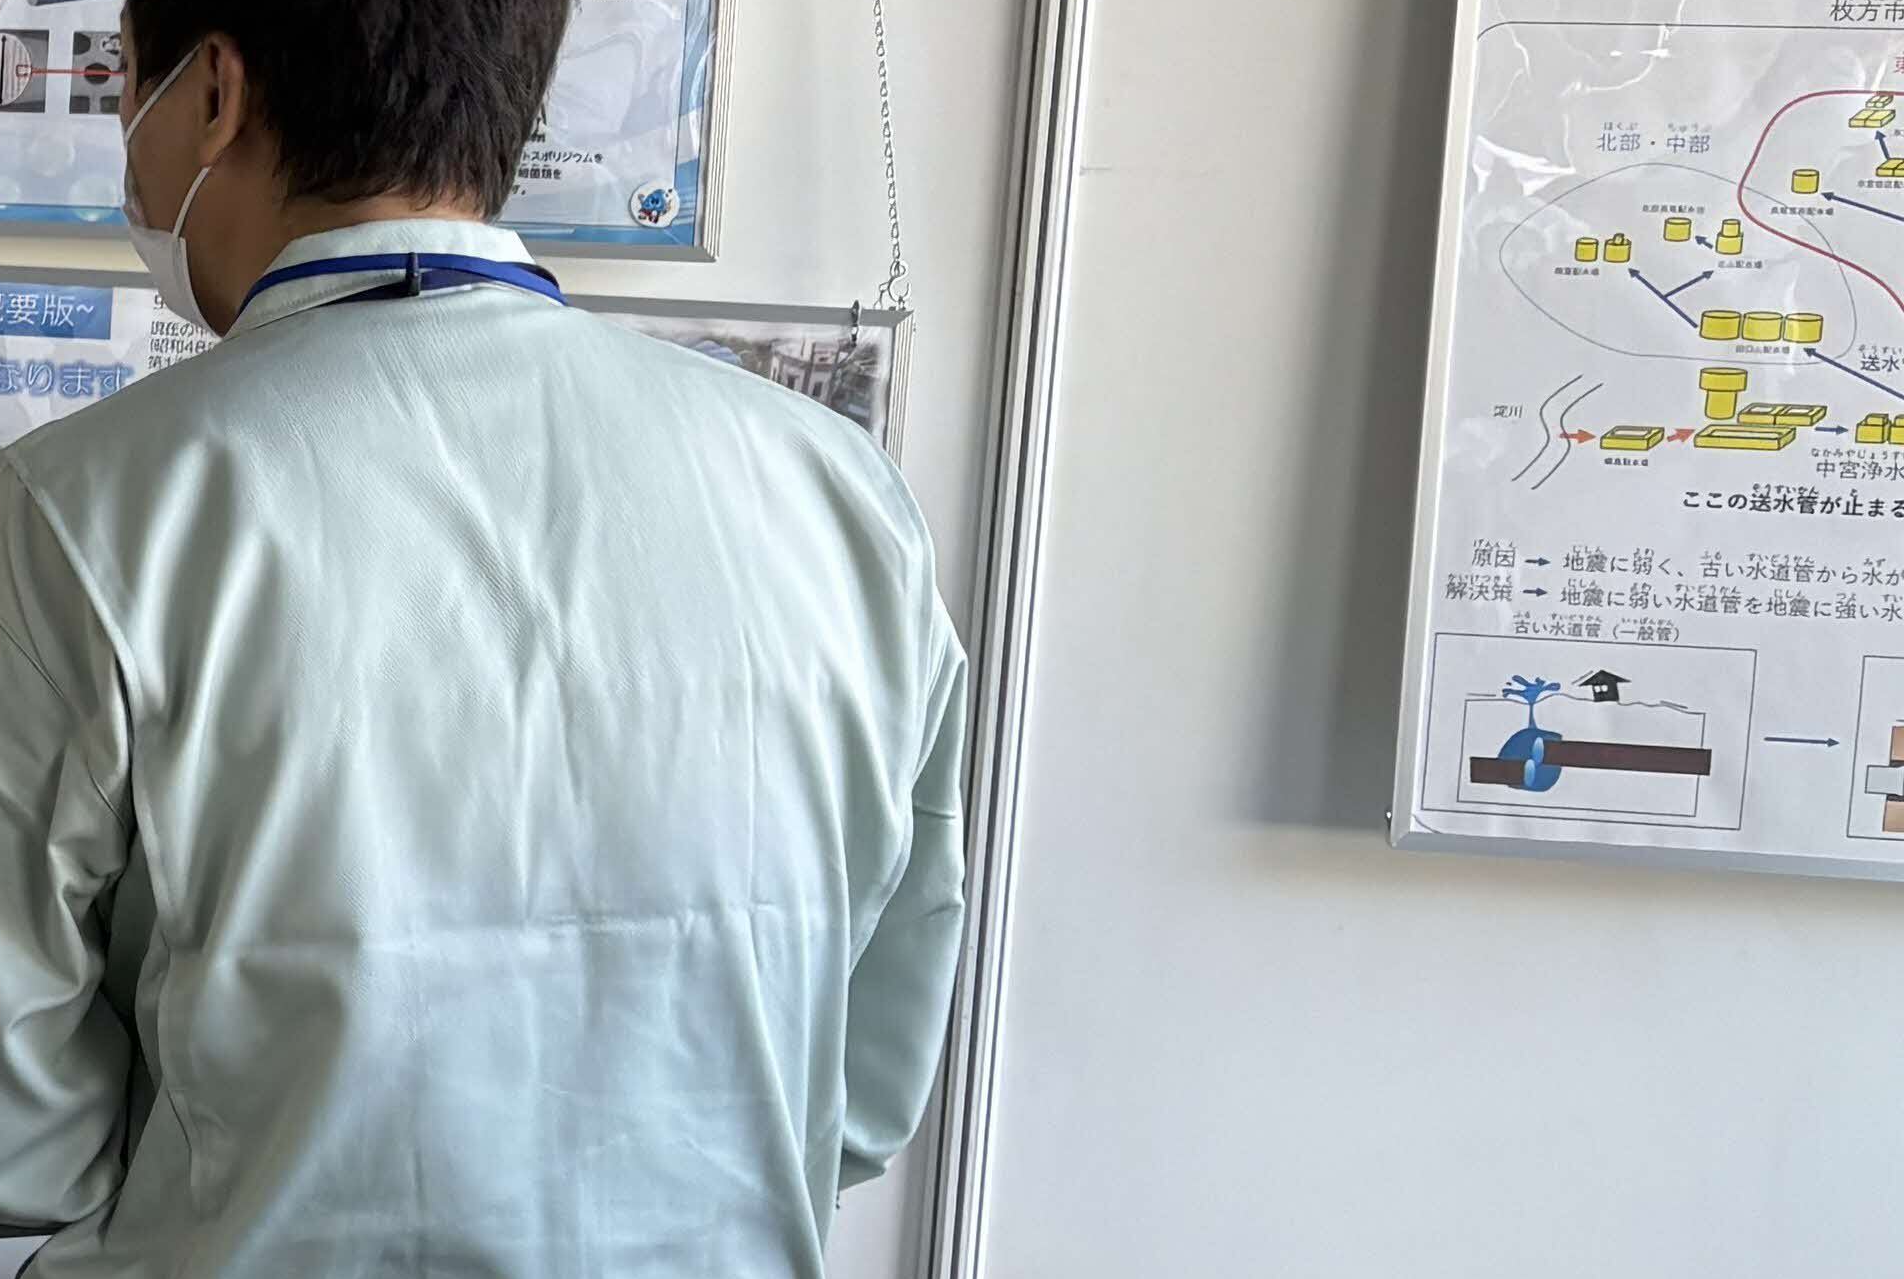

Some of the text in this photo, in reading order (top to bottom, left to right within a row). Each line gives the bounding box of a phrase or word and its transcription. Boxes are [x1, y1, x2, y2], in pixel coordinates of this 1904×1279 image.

[1597, 132, 1711, 154] 北部・中部
[1860, 354, 1904, 372] 送水
[1816, 462, 1904, 481] 中宮浄水
[1682, 491, 1904, 518] ここの送水管が止まる
[1472, 548, 1515, 568] 原因
[1445, 582, 1904, 622] 解決策 地震に弱い水道管を地震に強い水
